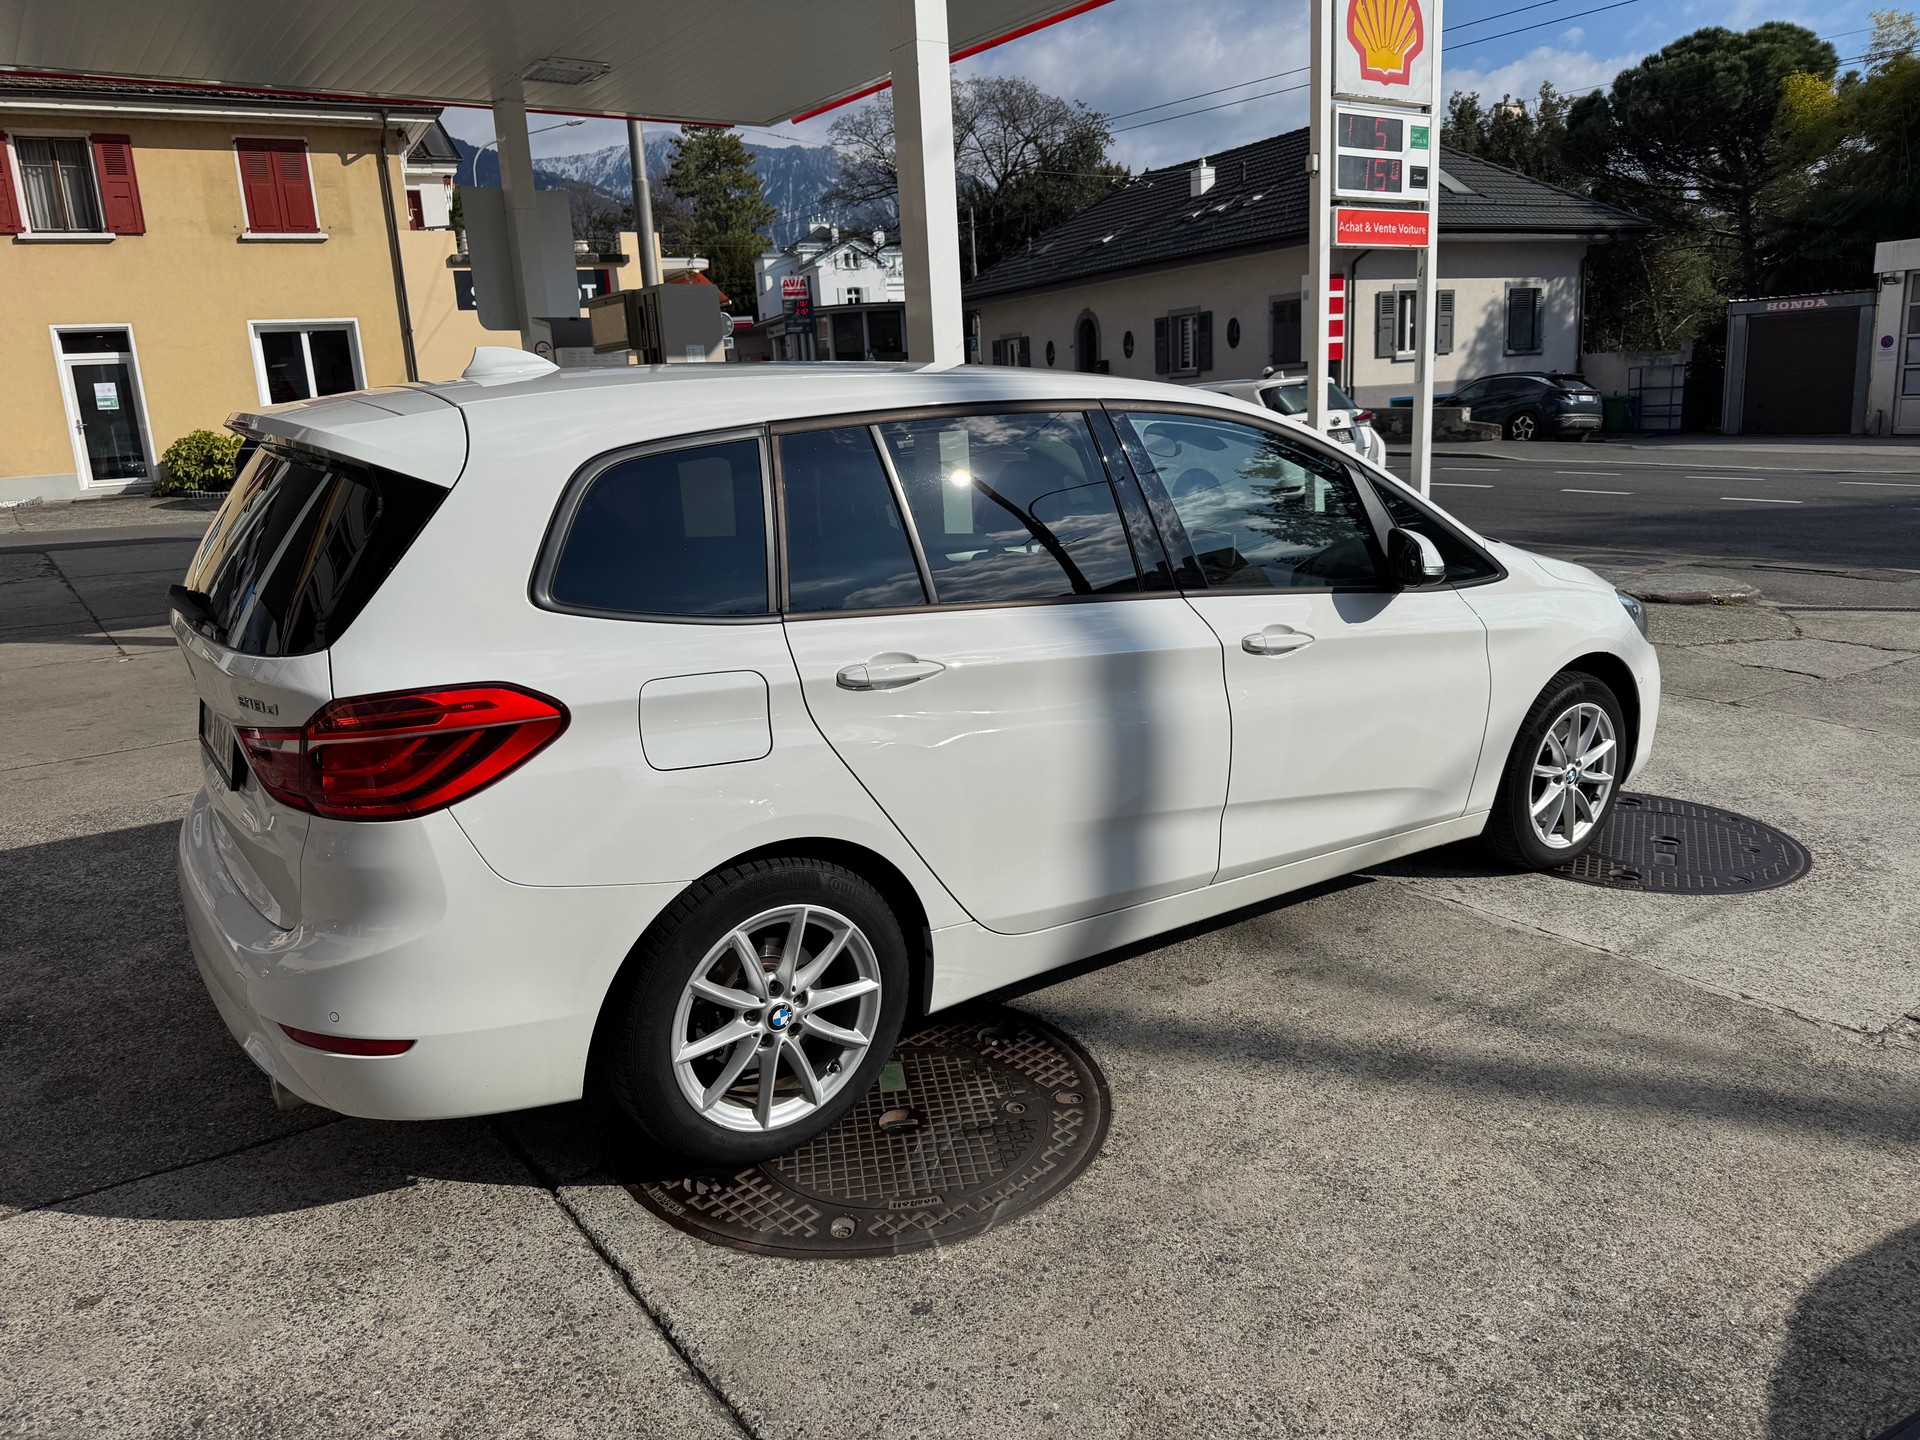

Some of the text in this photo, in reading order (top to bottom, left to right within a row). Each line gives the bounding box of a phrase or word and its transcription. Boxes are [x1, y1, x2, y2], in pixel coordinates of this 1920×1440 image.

[1338, 220, 1427, 235] Achat & Vente Voiture
[782, 276, 807, 288] AVIA
[1766, 298, 1828, 311] HONDA
[1538, 689, 1576, 735] Continental
